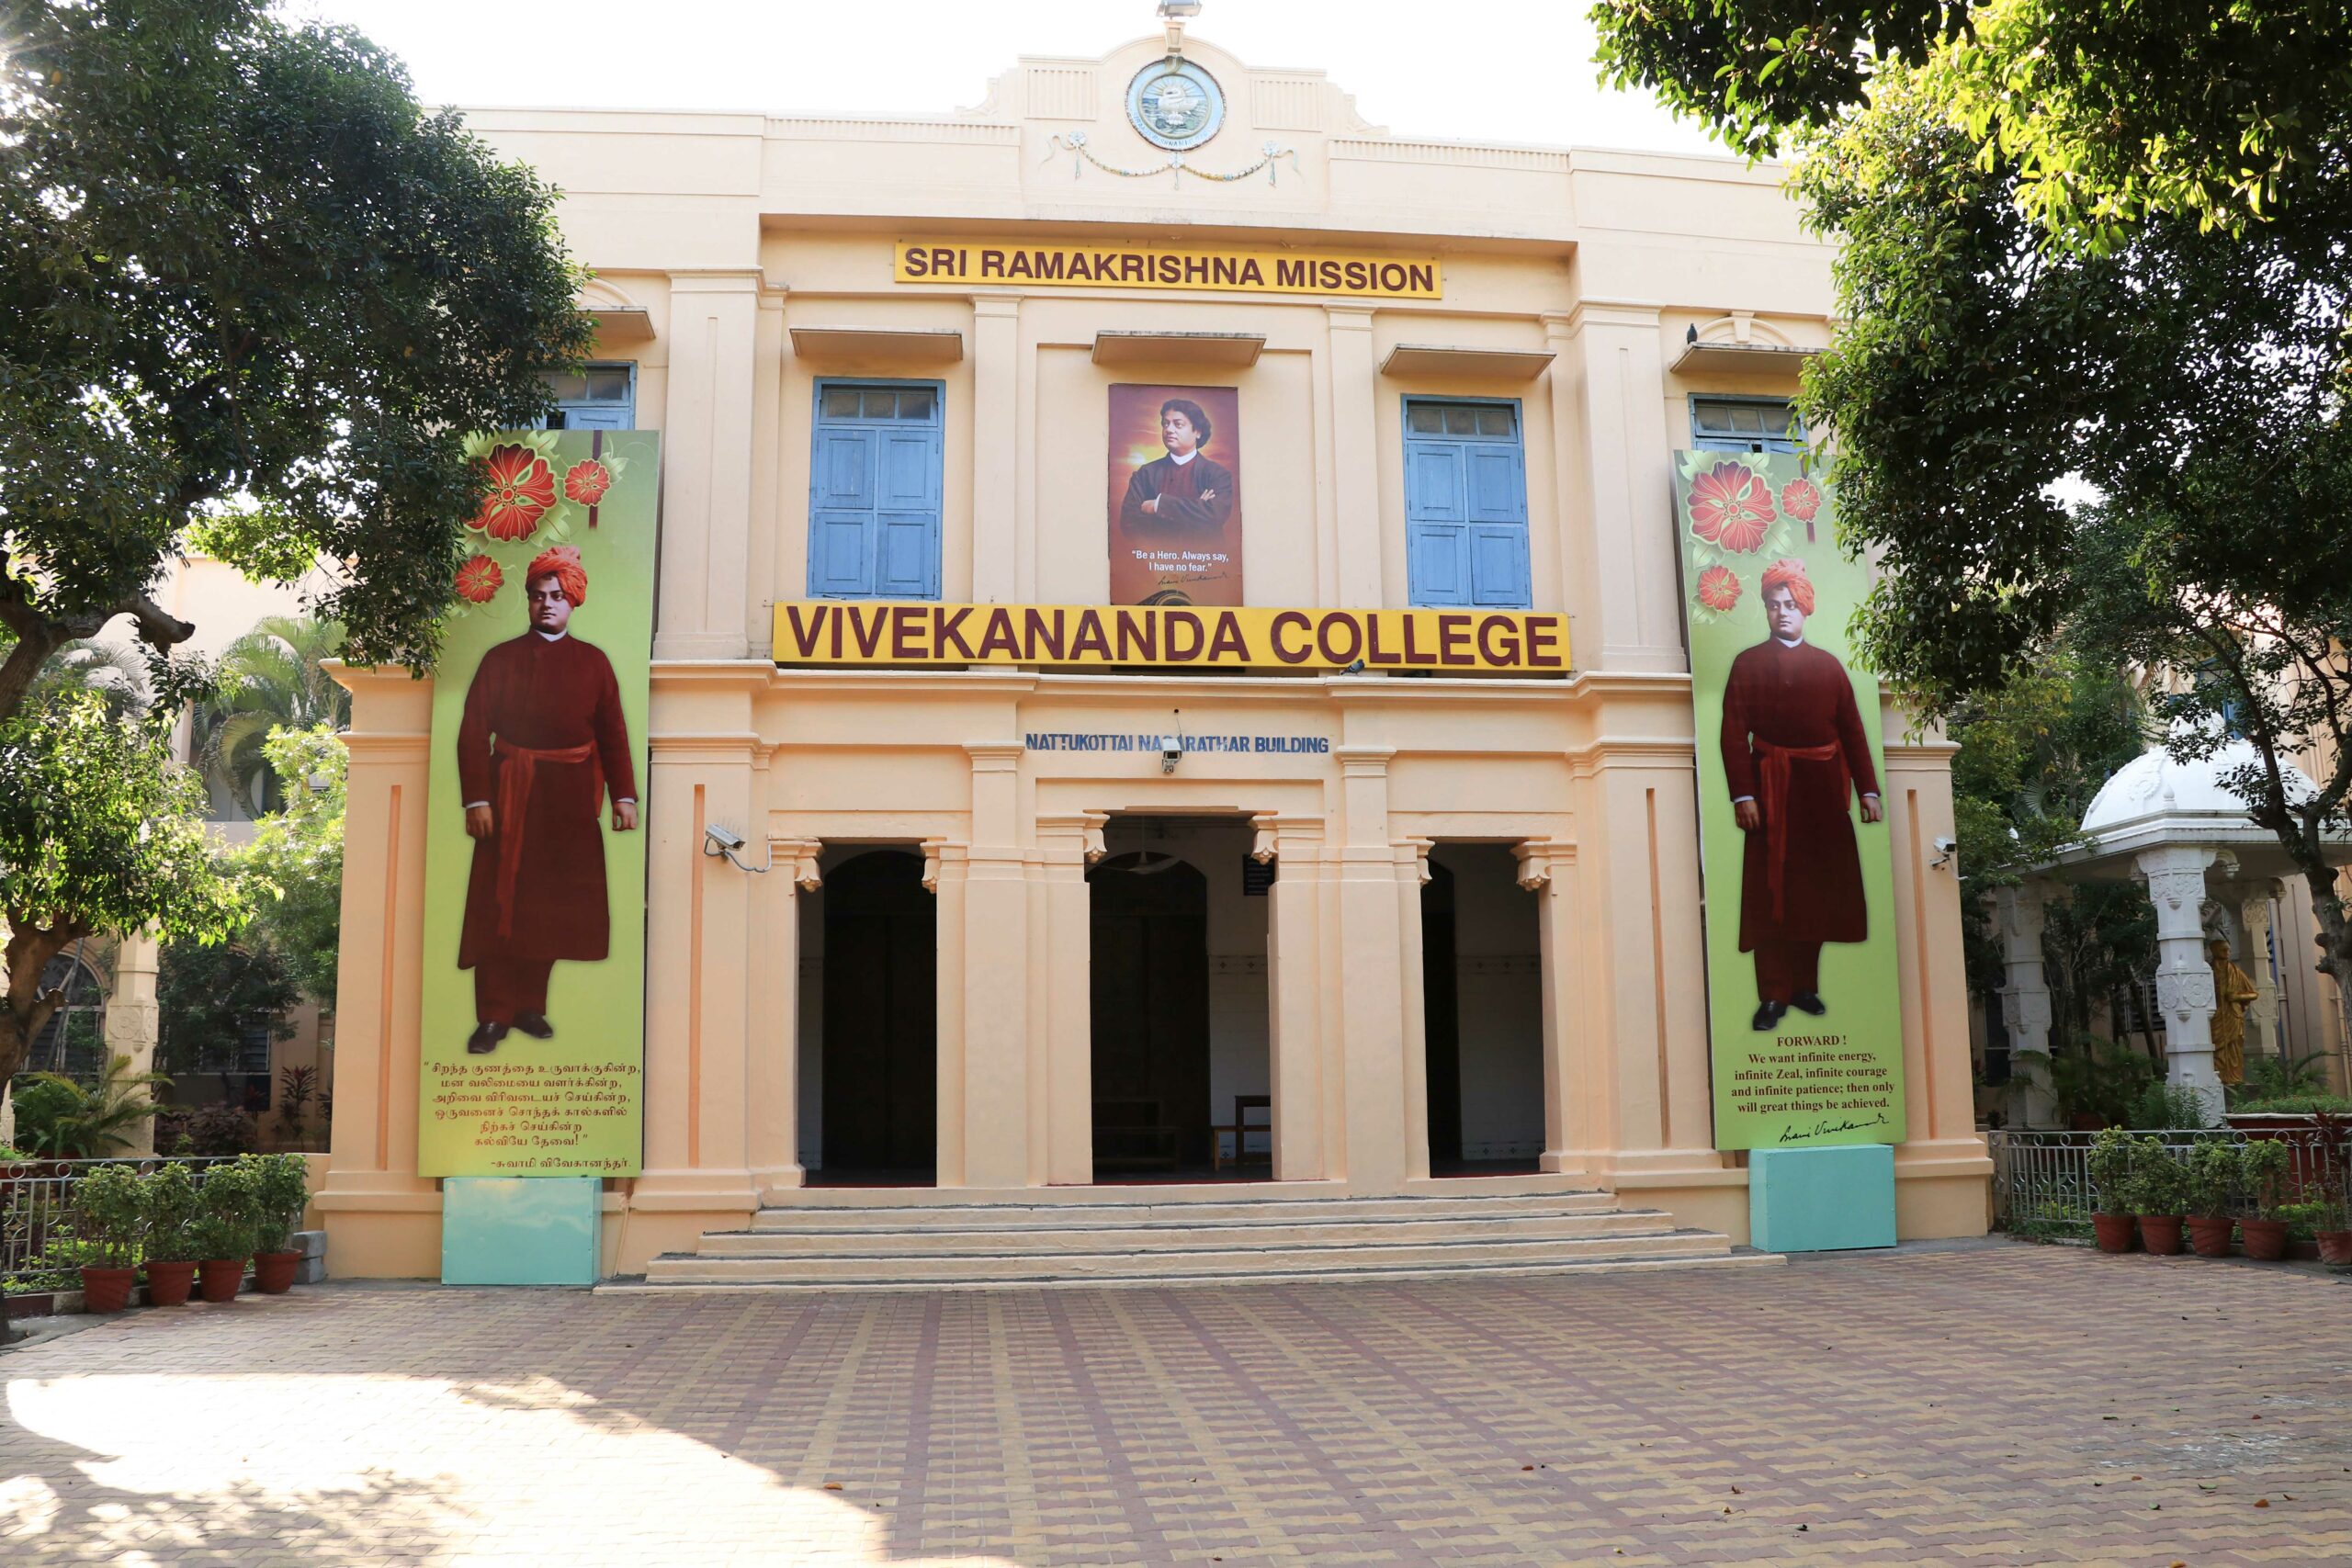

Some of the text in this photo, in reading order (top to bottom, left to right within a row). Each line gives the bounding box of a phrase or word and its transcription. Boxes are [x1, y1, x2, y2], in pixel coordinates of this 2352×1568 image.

[905, 248, 1433, 291] SRI RAMAKRISHNA MISSION
[1132, 550, 1148, 559] “Be
[1158, 551, 1180, 559] Hero.
[1182, 551, 1211, 562] Always
[1213, 554, 1229, 562] say,
[1148, 562, 1152, 570] I
[1189, 563, 1212, 571] fear.”
[786, 605, 1559, 667] VIVEKANANDA COLLEGE
[1025, 734, 1134, 751] NATTUKOTTAI
[1254, 737, 1329, 753] BUILDING
[1777, 1035, 1839, 1047] FORWARD
[1748, 1052, 1876, 1064] We want infinite energy,
[1735, 1067, 1887, 1080] infinite Zeal, infinite courage
[441, 1079, 464, 1088] மன
[1731, 1081, 1894, 1097] and infinite patience; then only
[1738, 1098, 1890, 1114] will great things be achieved.
